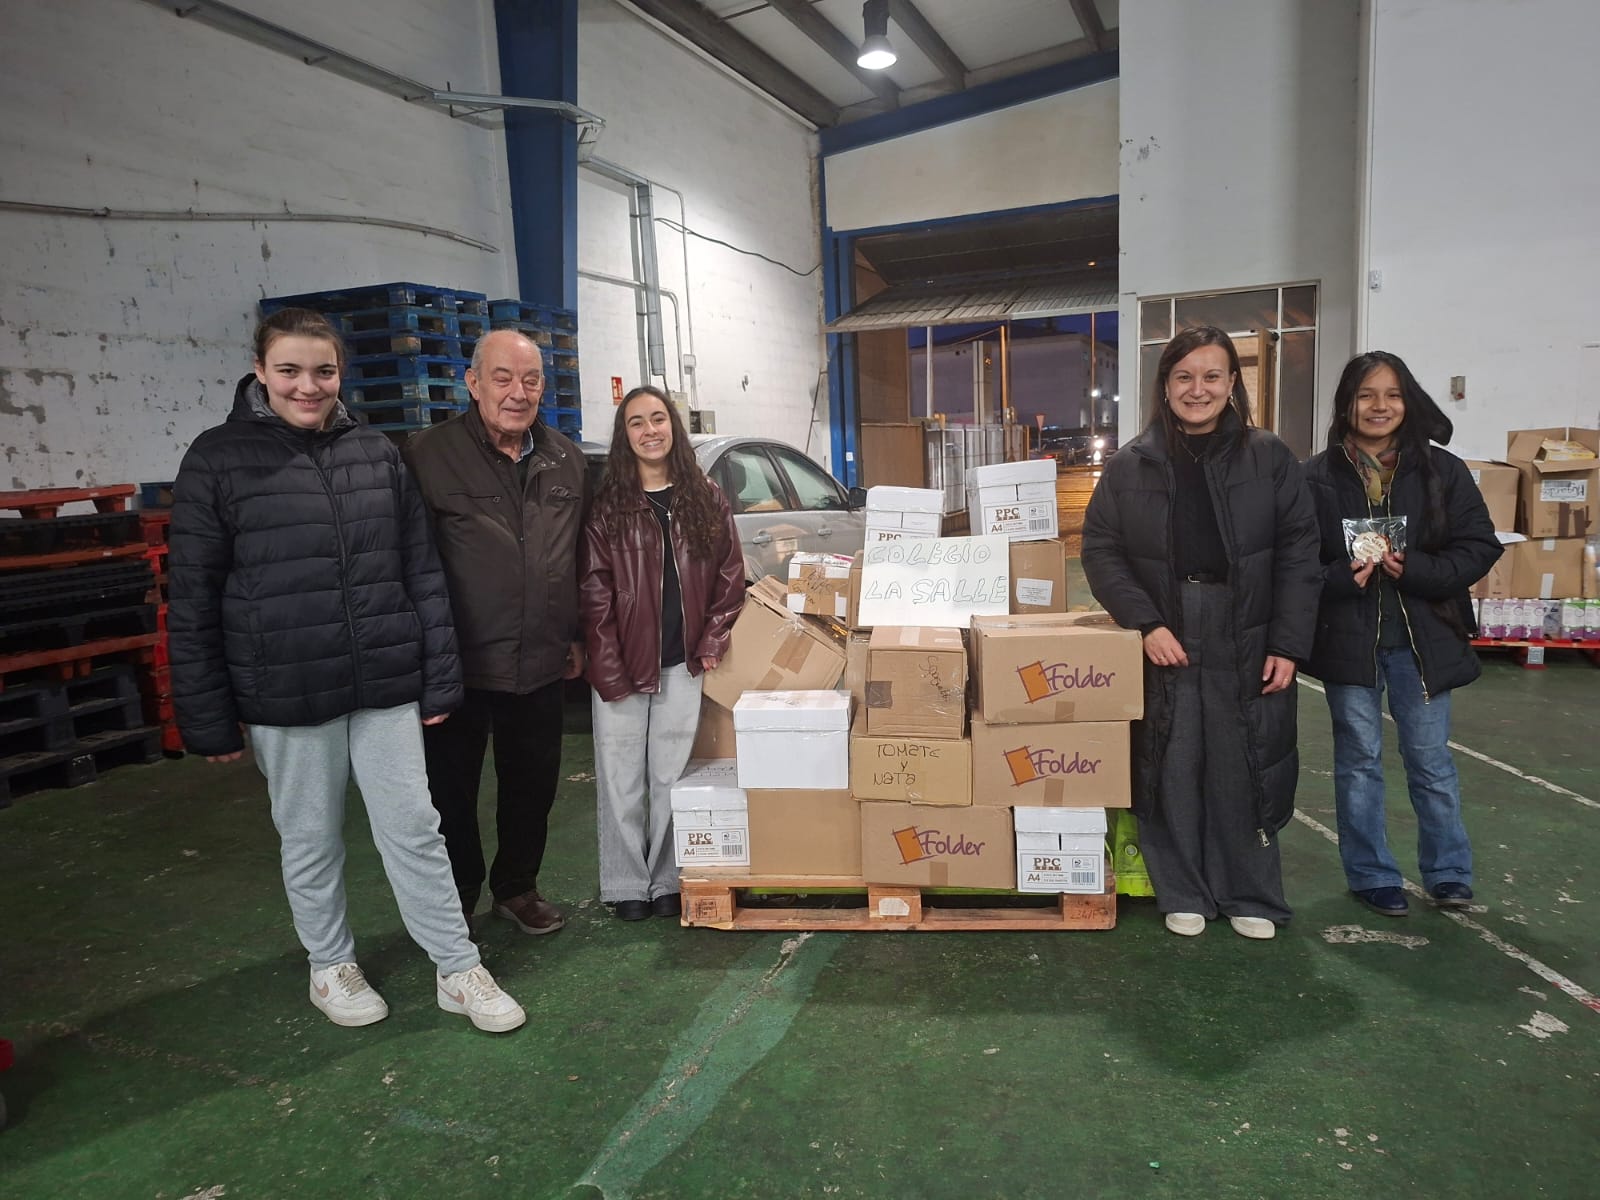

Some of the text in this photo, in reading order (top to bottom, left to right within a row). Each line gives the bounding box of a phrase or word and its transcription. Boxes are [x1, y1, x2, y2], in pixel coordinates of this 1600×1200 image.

[995, 507, 1020, 518] PPC
[991, 524, 1003, 533] A4
[865, 580, 902, 600] LA
[910, 576, 1007, 604] SALLE
[1039, 663, 1116, 690] Folder
[1025, 749, 1101, 775] Folder
[687, 832, 712, 842] PPC
[912, 829, 986, 856] Folder
[683, 847, 696, 857] A4
[1033, 857, 1062, 868] PPC
[1027, 873, 1041, 882] A4
